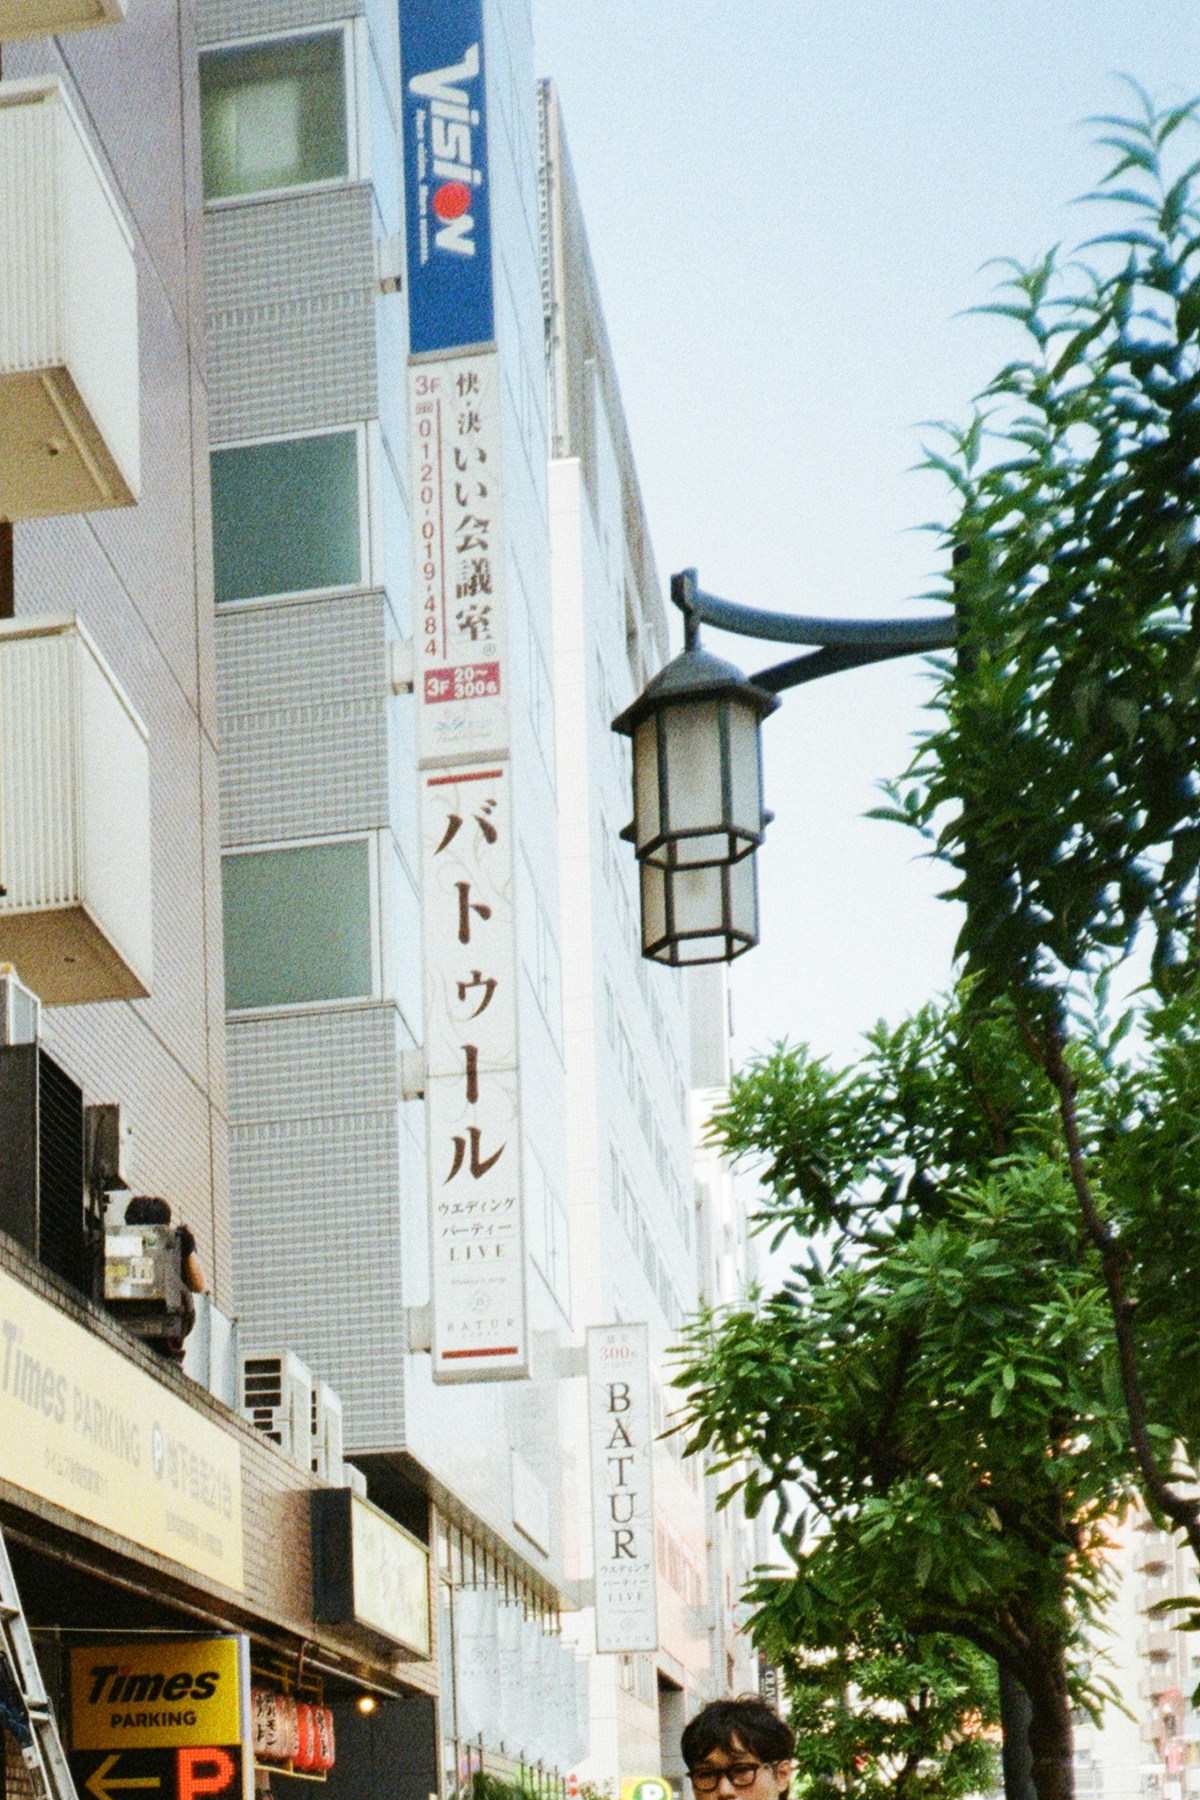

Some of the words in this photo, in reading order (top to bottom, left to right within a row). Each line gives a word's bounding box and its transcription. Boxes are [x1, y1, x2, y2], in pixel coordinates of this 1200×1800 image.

[415, 375, 440, 396] 3F
[427, 677, 450, 698] 3F
[433, 798, 507, 1186] バトゥール
[449, 1244, 505, 1261] LIVE
[2, 1318, 67, 1425] Times
[73, 1385, 141, 1467] PARKING
[605, 1381, 637, 1560] BATUR
[85, 1664, 221, 1704] Times
[110, 1710, 197, 1729] PARKING
